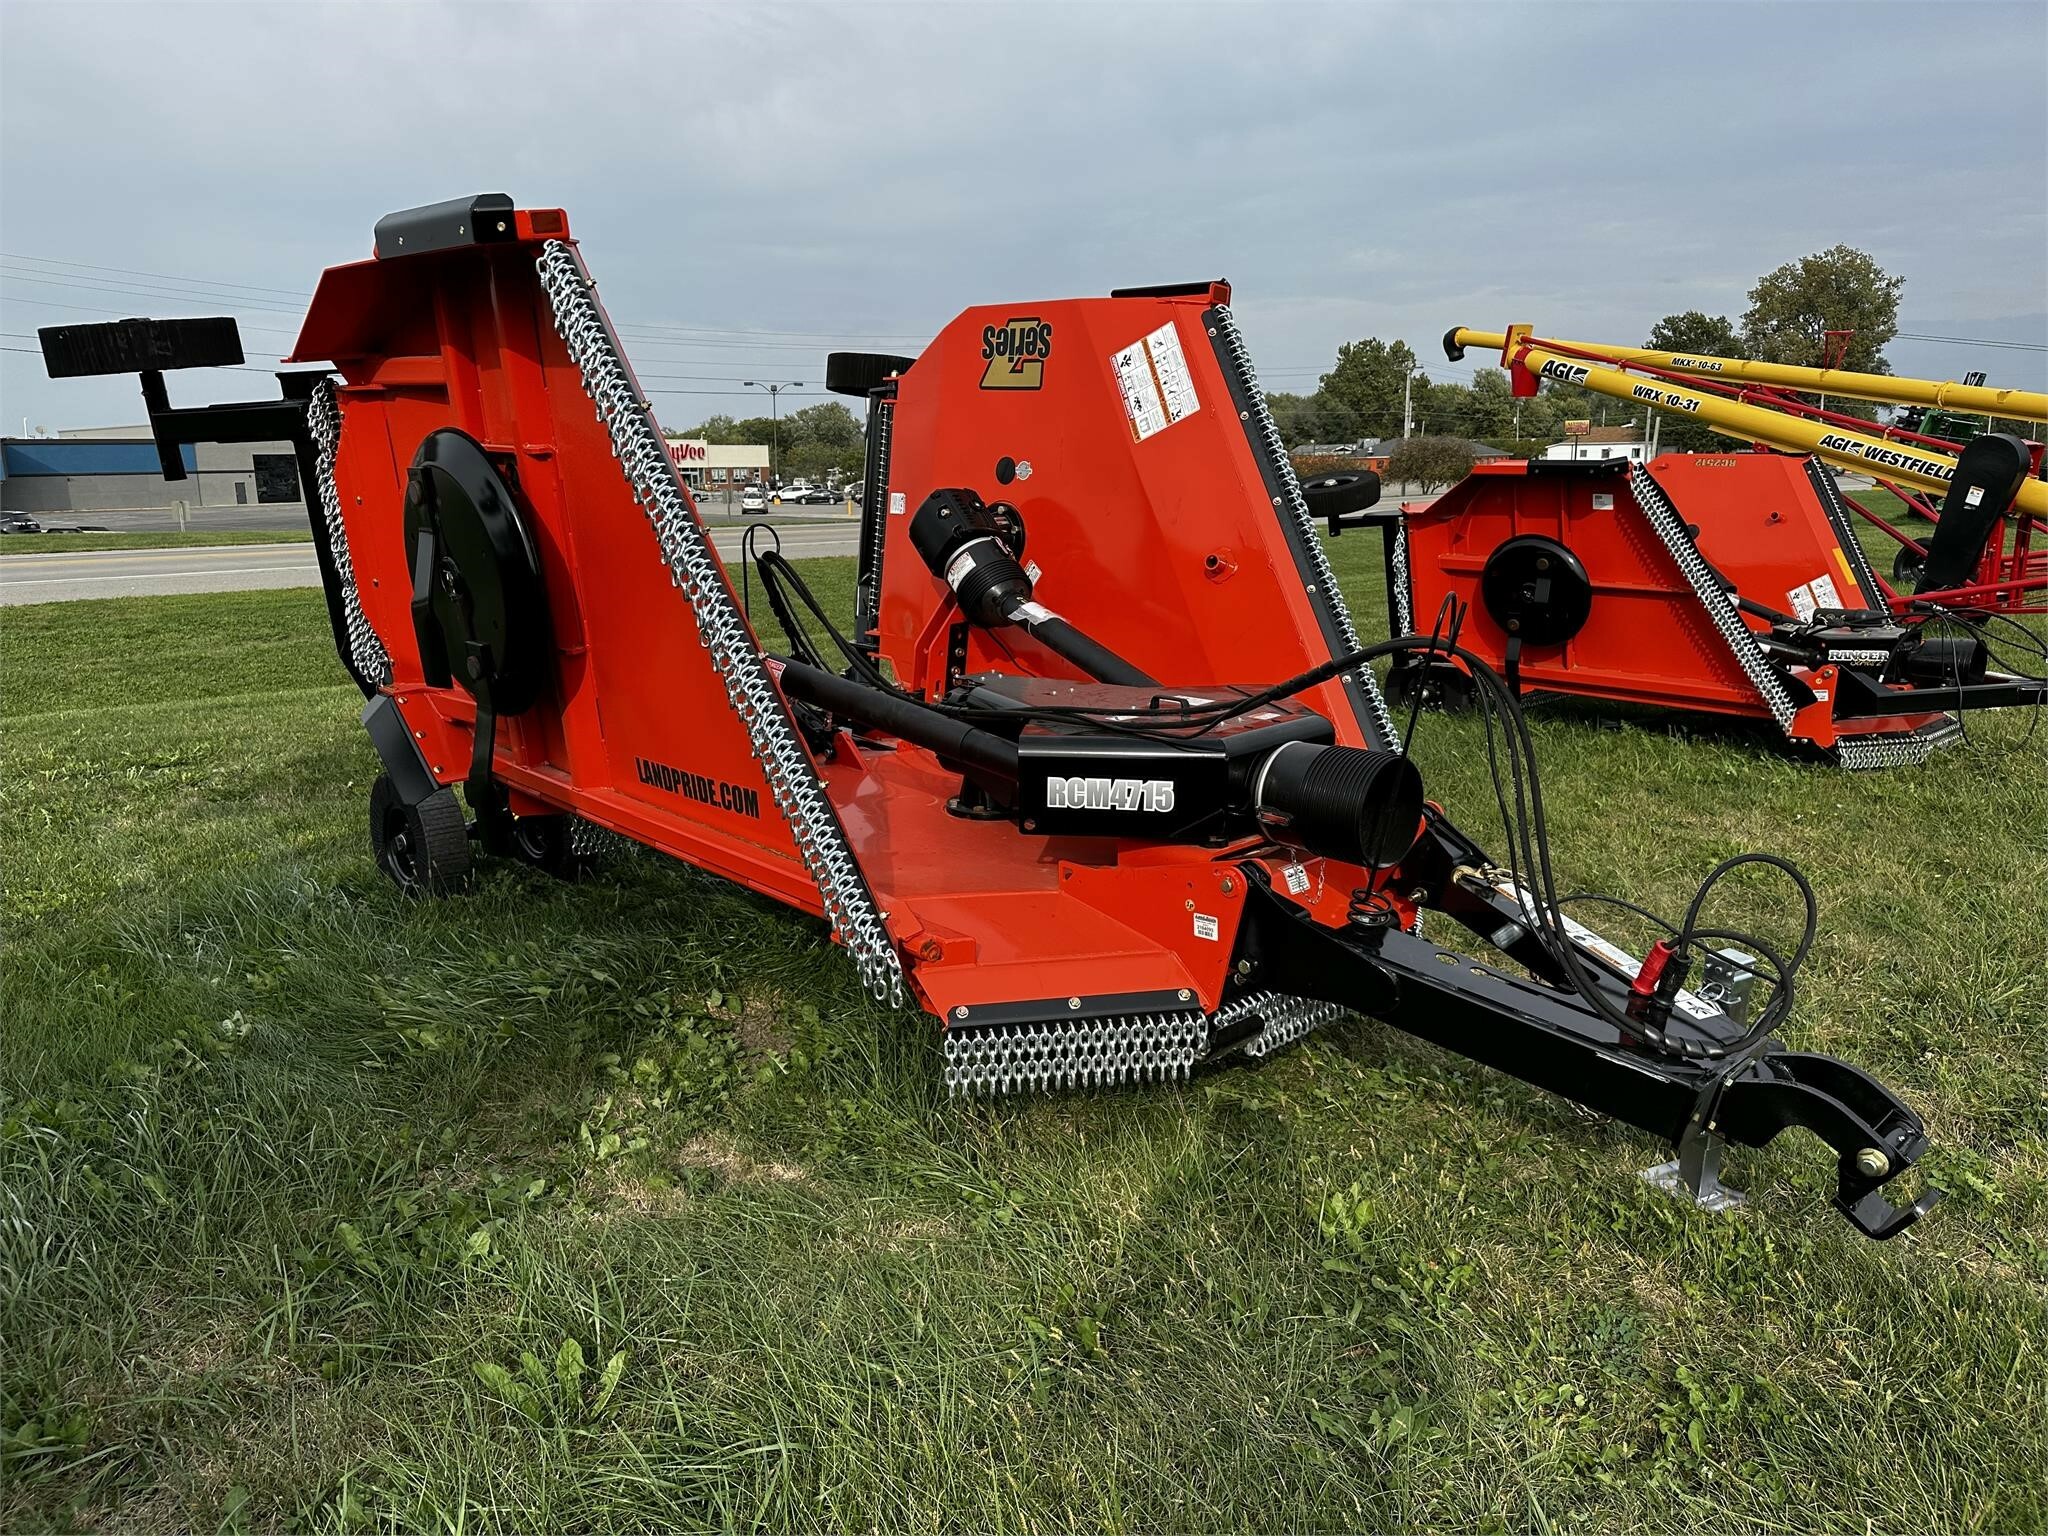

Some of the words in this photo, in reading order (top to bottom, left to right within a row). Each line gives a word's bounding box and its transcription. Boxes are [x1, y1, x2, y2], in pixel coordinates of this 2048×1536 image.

[1540, 359, 1575, 381] AGI
[1697, 360, 1723, 371] 10-63
[1632, 384, 1662, 402] WRX
[1664, 393, 1701, 413] 10-31
[1819, 434, 1852, 453] AGI
[1862, 445, 1957, 481] WESTFIELD
[1828, 649, 1890, 662] RANGER
[634, 755, 760, 820] LANDPRIDE.COM
[1047, 776, 1175, 813] RCM4715
